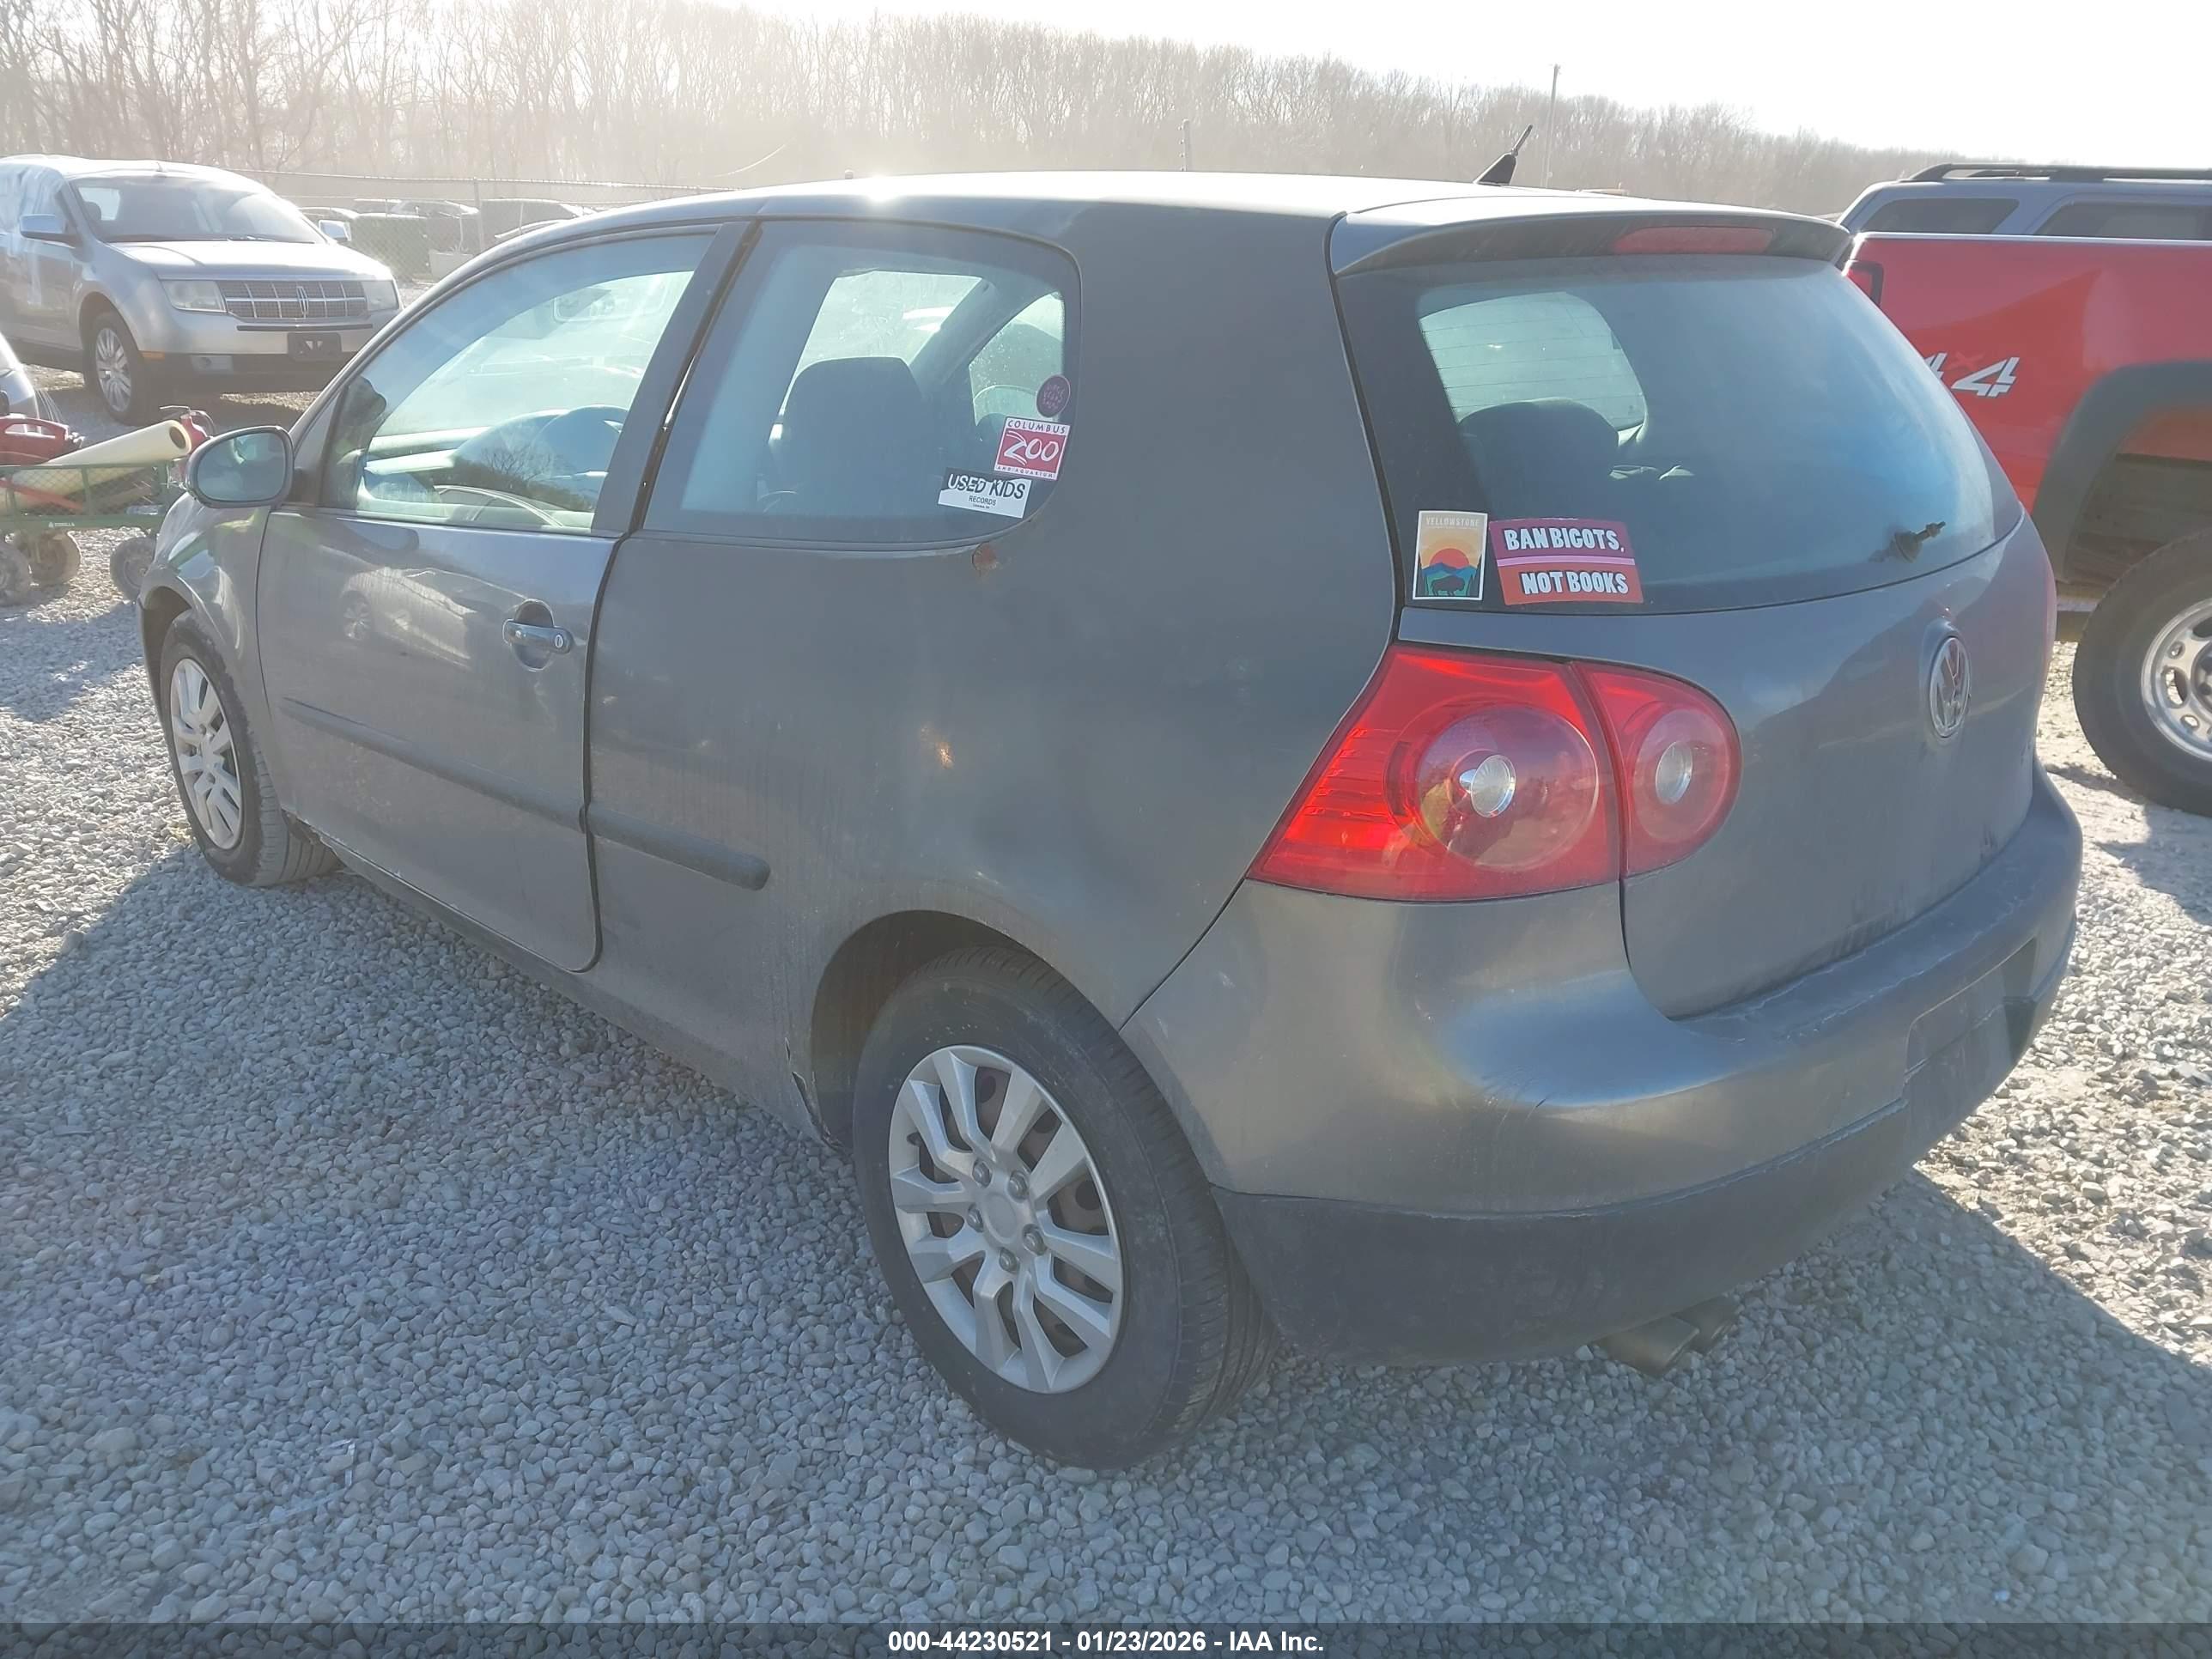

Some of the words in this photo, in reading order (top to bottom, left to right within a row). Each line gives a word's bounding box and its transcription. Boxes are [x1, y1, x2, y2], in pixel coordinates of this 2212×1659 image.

[1007, 419, 1066, 434] COLUMBUS
[947, 473, 986, 494] USED
[988, 478, 1026, 499] KIDS
[968, 495, 997, 507] RECORDS
[1425, 516, 1480, 527] YELLOWSTONE
[1504, 528, 1549, 550] BAN
[1520, 571, 1564, 594] NOT
[1565, 571, 1629, 594] BOOKS
